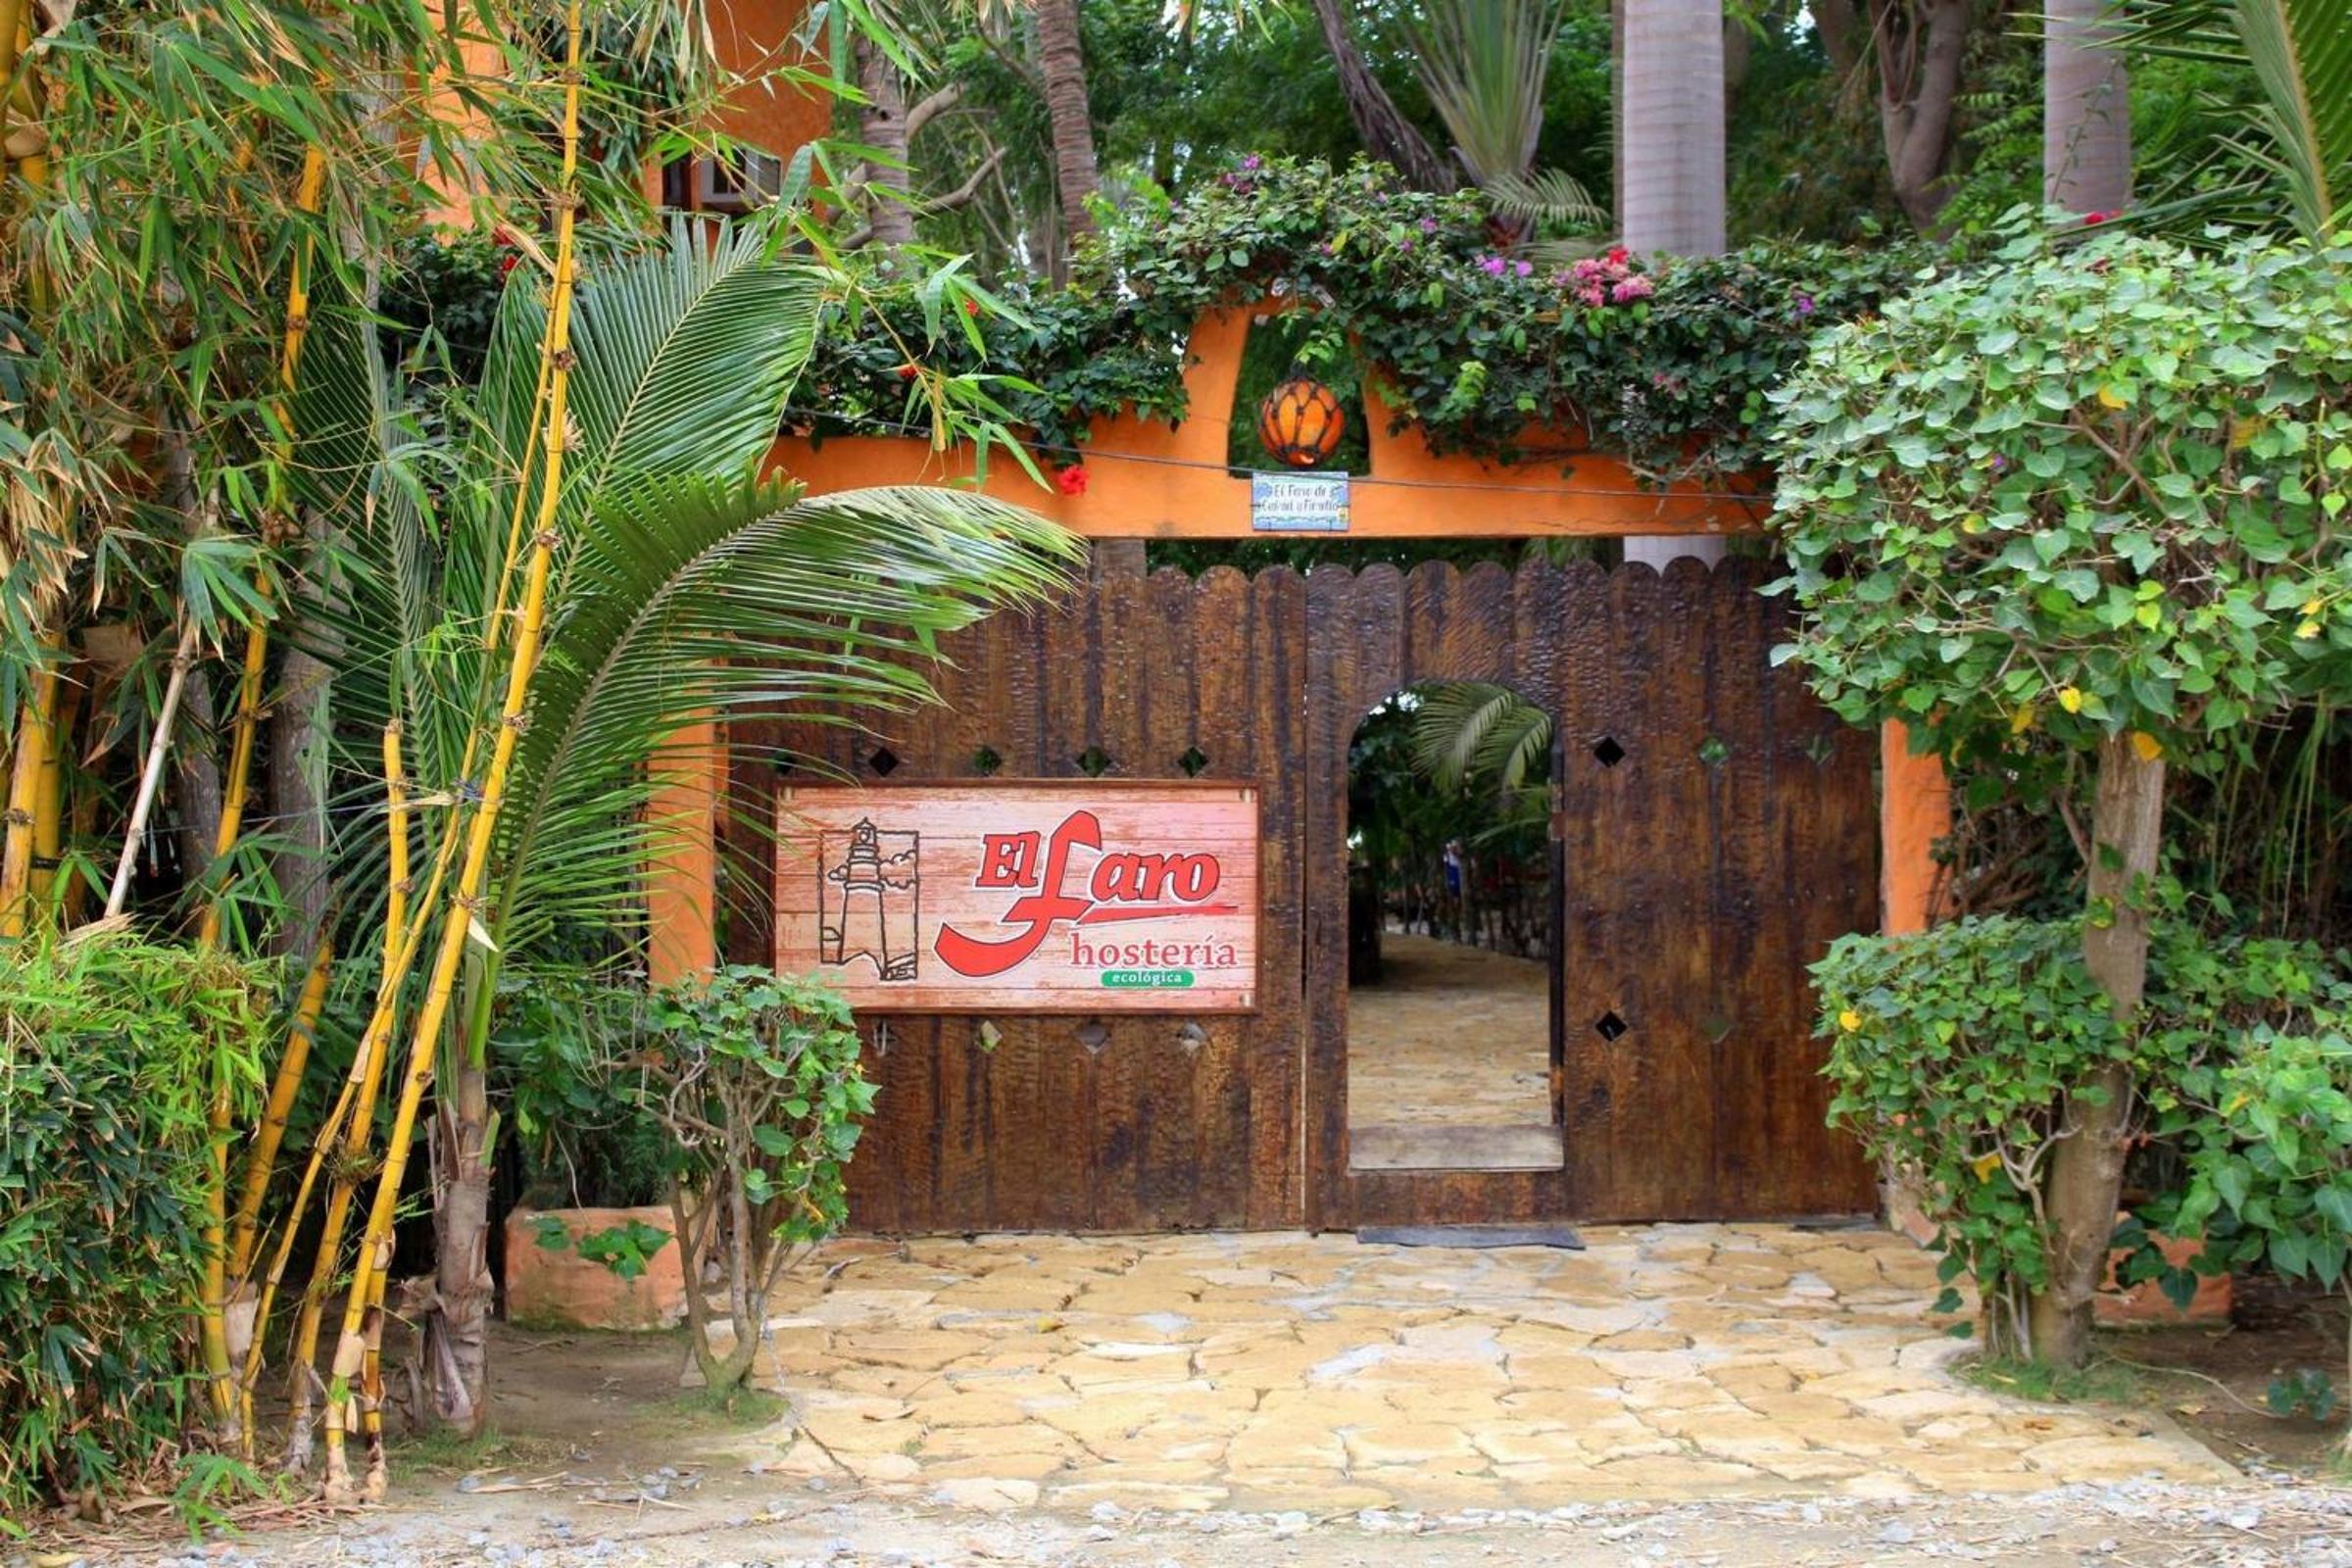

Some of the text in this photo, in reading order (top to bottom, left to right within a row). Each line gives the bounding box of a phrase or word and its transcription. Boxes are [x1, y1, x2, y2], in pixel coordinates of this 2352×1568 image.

[975, 830, 1041, 888] El
[1070, 932, 1238, 966] hostería
[1112, 972, 1183, 986] ecológica
